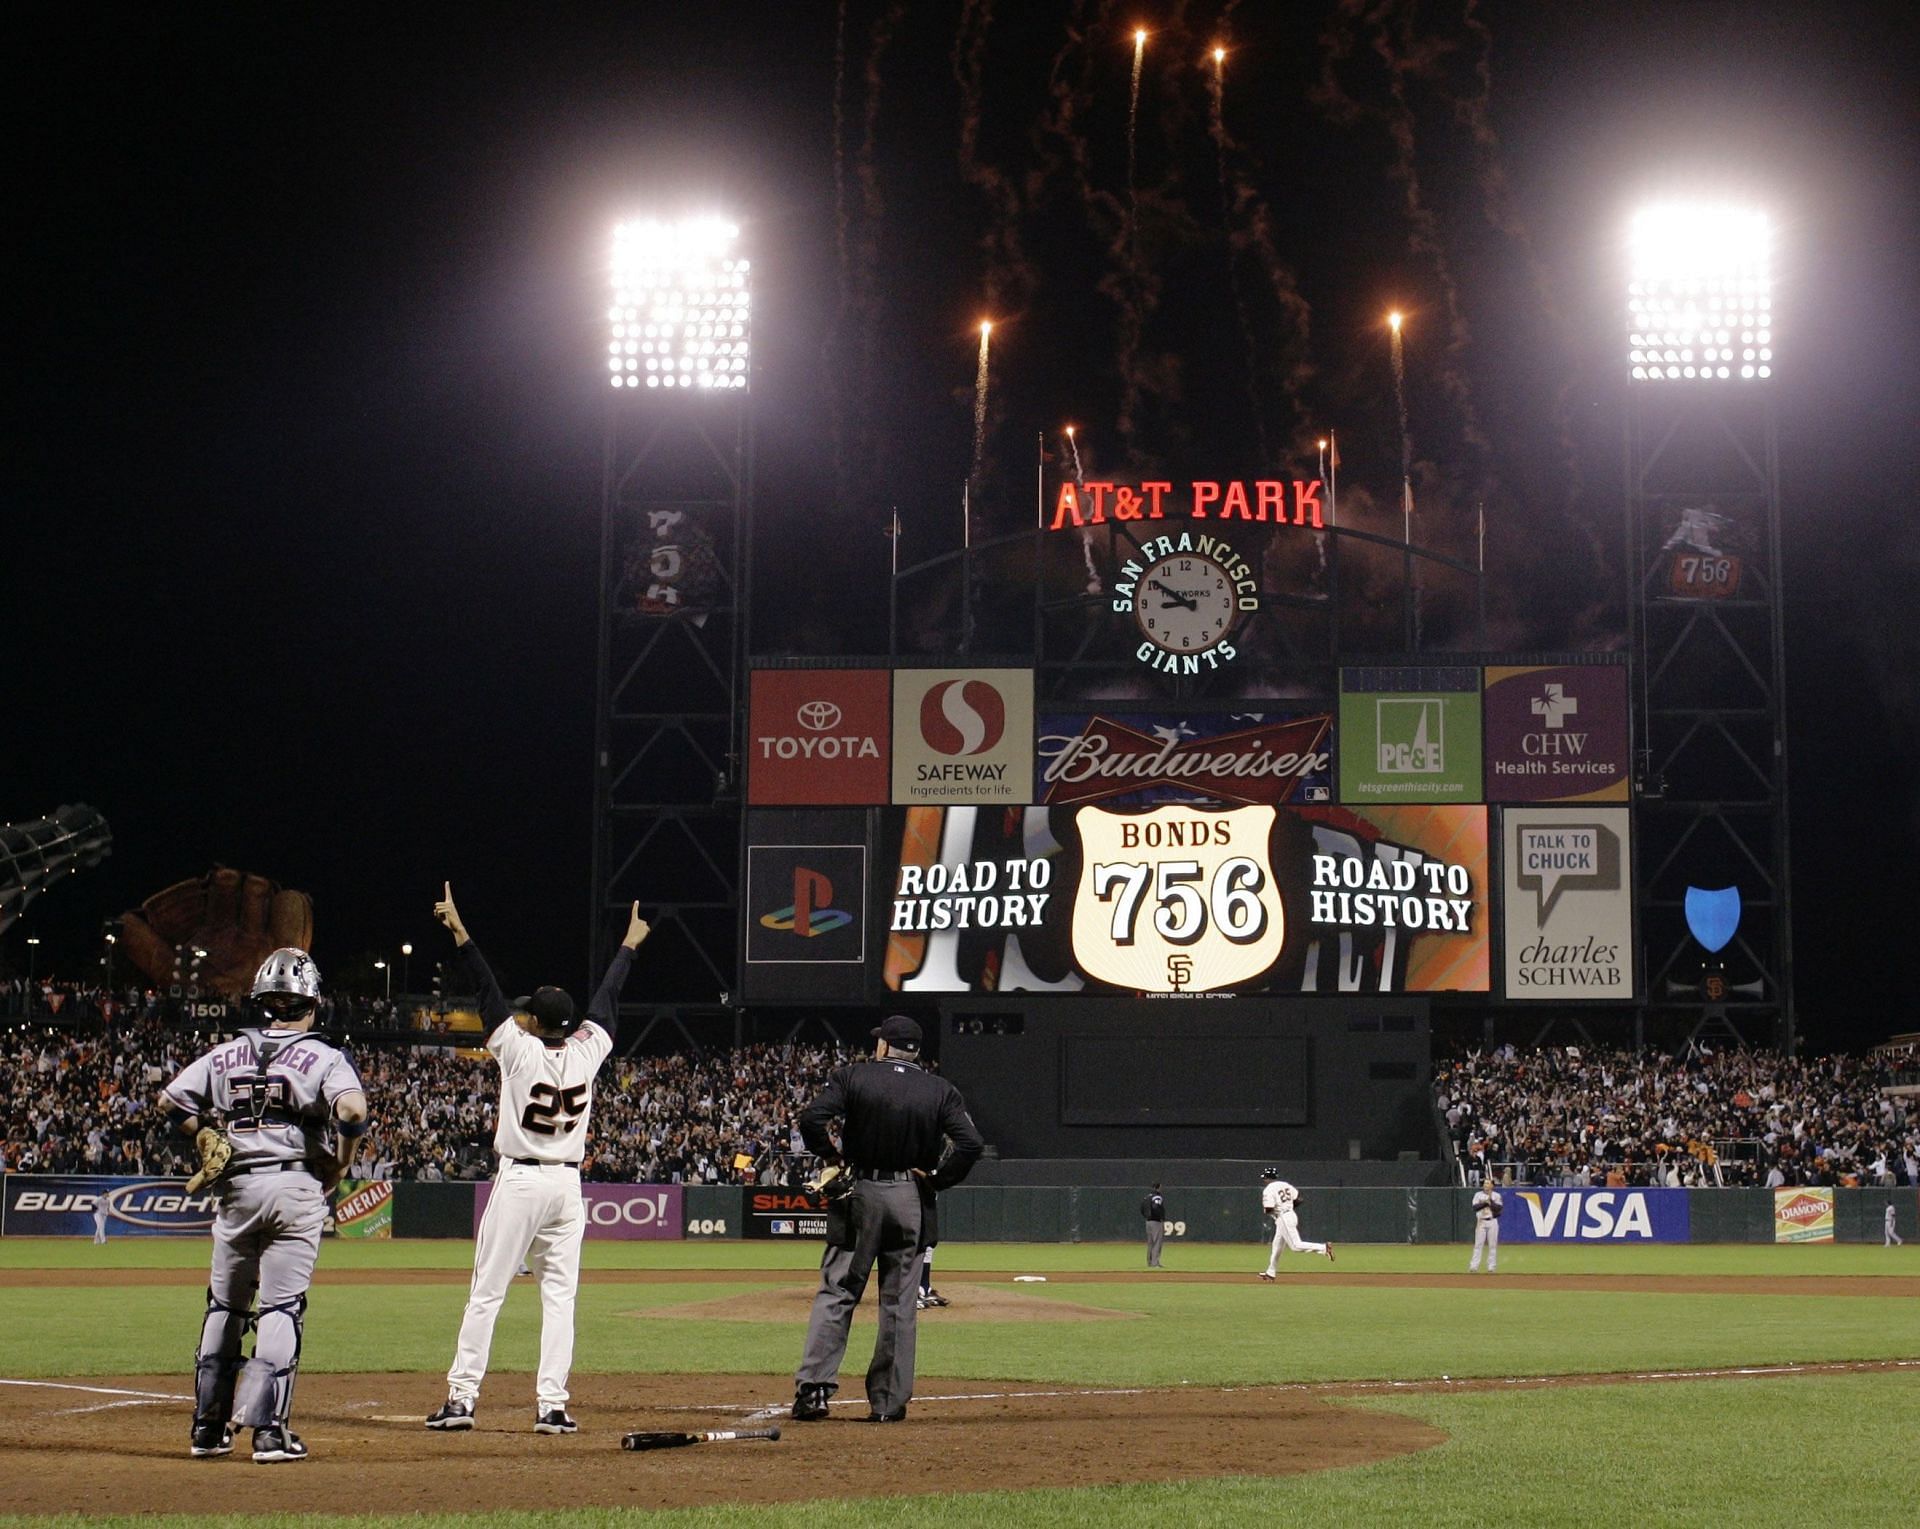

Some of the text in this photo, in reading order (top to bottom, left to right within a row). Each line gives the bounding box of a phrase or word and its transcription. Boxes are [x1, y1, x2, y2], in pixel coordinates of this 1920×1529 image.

[1050, 480, 1323, 531] AT&T PARK
[1113, 532, 1258, 613] SAN FRANCISCO
[1162, 566, 1171, 577] 11
[1180, 560, 1191, 571] 12
[1203, 565, 1208, 576] 1
[1681, 557, 1731, 584] 756
[1216, 578, 1223, 589] 2
[1141, 599, 1148, 609] 9
[1223, 598, 1230, 608] 3
[1148, 618, 1155, 629] 8
[1215, 618, 1222, 628] 4
[1163, 631, 1170, 641] 7
[1182, 636, 1189, 647] 6
[1201, 631, 1209, 641] 5
[1136, 640, 1237, 675] GIANTS
[758, 736, 880, 759] TOYOTA
[1521, 733, 1588, 756] CHW
[1038, 733, 1330, 783] Budweiser
[1381, 742, 1440, 771] PG&E
[917, 764, 1008, 781] SAFEWAY
[1495, 761, 1616, 775] Health Services
[910, 785, 973, 798] Ingredients
[976, 785, 992, 796] for
[1358, 782, 1464, 795] letsgreenthiscity.com
[1121, 820, 1231, 848] BONDS
[1528, 835, 1591, 849] TALK TO
[1528, 853, 1591, 869] CHUCK
[898, 858, 1051, 896] ROAD TO
[1312, 855, 1469, 896] ROAD TO
[1093, 856, 1269, 946] 756
[1310, 890, 1472, 931] HISTORY
[890, 894, 1050, 931] HISTORY
[1519, 936, 1618, 964] charles
[1518, 967, 1621, 986] SCHWAB
[521, 1081, 588, 1136] 25
[336, 1182, 393, 1222] EMERALD
[1278, 1188, 1291, 1203] 25
[1515, 1192, 1653, 1239] VISA
[1781, 1201, 1829, 1220] DIAMOND
[688, 1219, 726, 1234] 404
